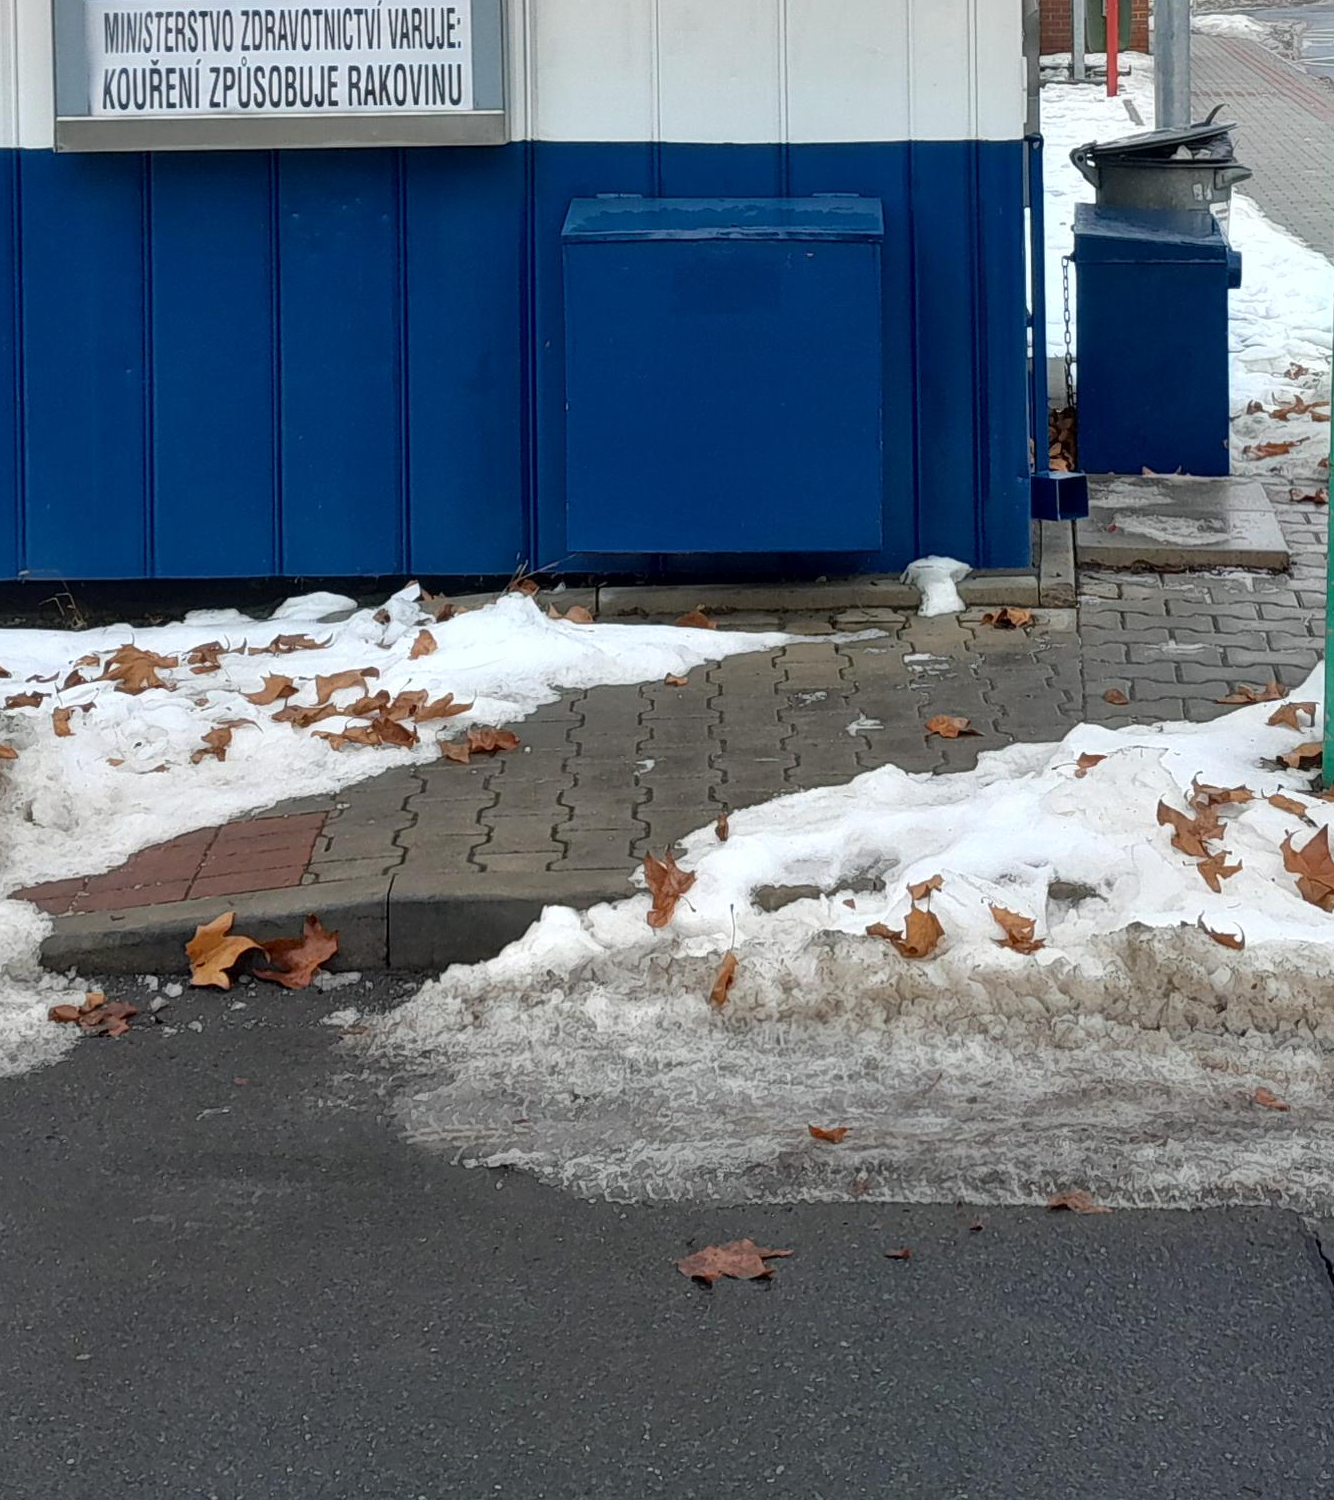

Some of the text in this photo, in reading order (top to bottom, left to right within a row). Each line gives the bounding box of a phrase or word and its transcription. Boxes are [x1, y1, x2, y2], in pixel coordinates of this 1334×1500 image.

[104, 0, 462, 54] MINISTERSTVO ZDRAVOTNICTVÍ VARUJE:
[102, 57, 462, 110] KOUŘENÍ ZPŮSOBUJE RAKOVINU
